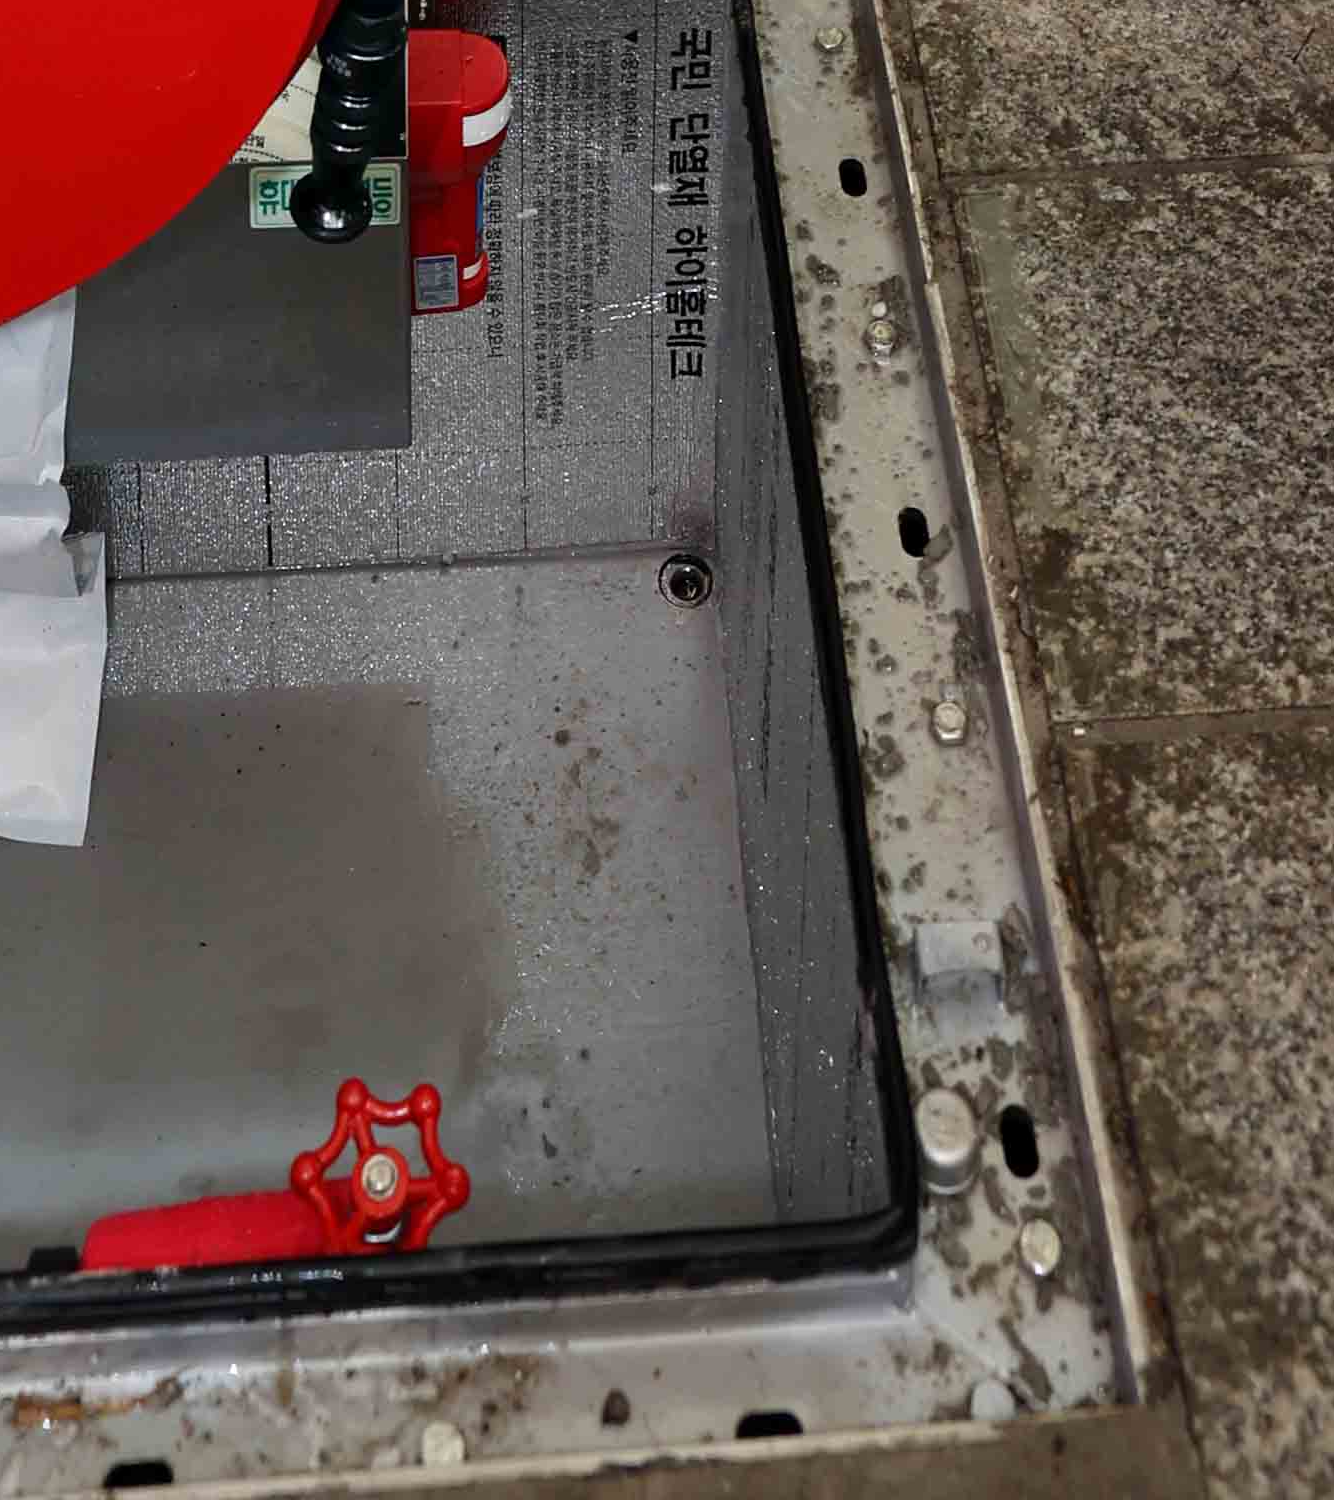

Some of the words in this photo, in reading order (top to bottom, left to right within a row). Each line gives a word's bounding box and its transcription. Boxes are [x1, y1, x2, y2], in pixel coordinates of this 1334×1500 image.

[670, 26, 713, 93] 국민
[667, 112, 710, 208] 단열재
[486, 199, 505, 225] 따라
[487, 307, 505, 319] 수
[667, 224, 708, 382] 하이홈테크
[486, 321, 505, 360] 있으니
